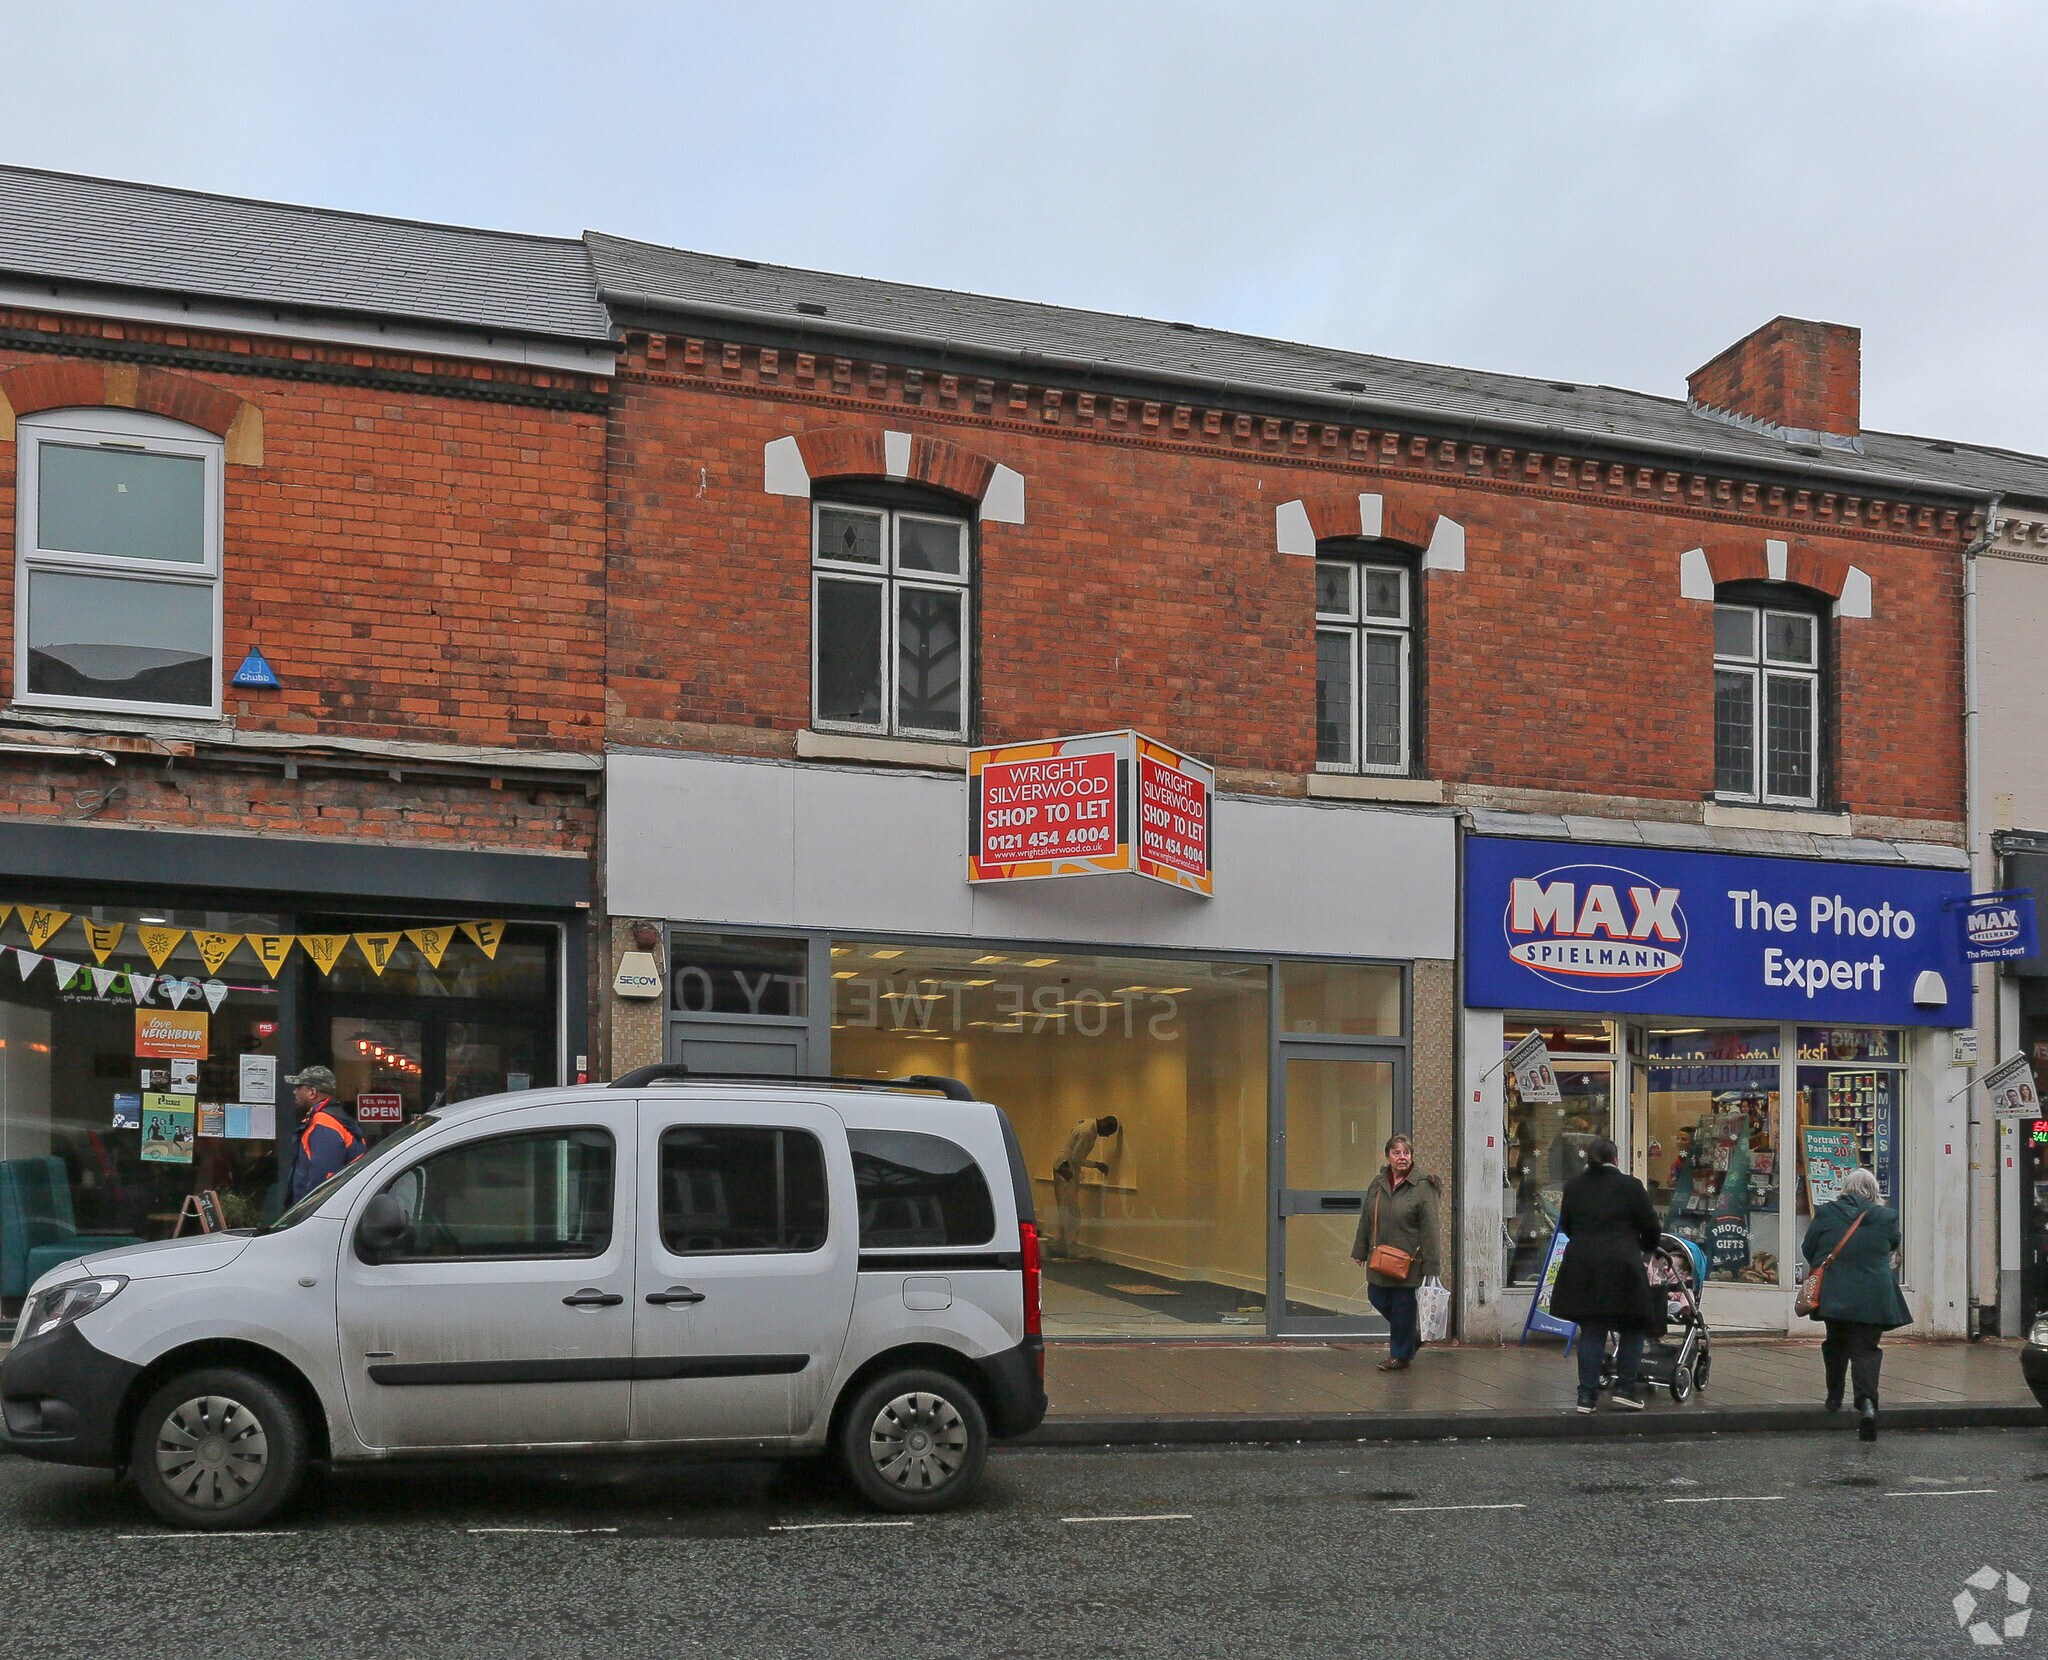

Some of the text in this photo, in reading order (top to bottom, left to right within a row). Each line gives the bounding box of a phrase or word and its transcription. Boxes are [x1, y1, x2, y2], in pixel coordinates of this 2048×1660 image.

[240, 673, 269, 682] Chubb
[1009, 760, 1087, 783] WRIGHT
[1154, 767, 1193, 797] WRIGHT
[989, 777, 1108, 804] SILVERWOOD
[1144, 781, 1203, 818] SILVERWOOD
[987, 799, 1110, 829] SHOP TO LET
[1144, 803, 1203, 842] SHOP TO LET
[988, 826, 1110, 850] 0121 454 4004
[1144, 830, 1203, 864] 0121 454 4004
[994, 843, 1102, 859] www.wrightsilverwood.co.uk
[1510, 877, 1681, 942] MAX
[1728, 889, 1916, 940] The Photo
[1967, 910, 2018, 931] MAX
[0, 910, 112, 951] ME
[1973, 930, 2015, 940] SPIELMANN
[1527, 945, 1666, 969] SPIELMANN
[1966, 947, 2025, 959] The Photo Expert
[619, 975, 656, 986] SECOM
[1764, 947, 1884, 999] Expert
[141, 1028, 203, 1041] NEIGHBOUR
[1986, 1057, 2027, 1086] INTERNATIONAL
[360, 1106, 400, 1117] OPEN
[1877, 1093, 1889, 1152] MUGS
[1806, 1134, 1840, 1145] Portrait
[1808, 1144, 1832, 1153] Packs
[1711, 1224, 1748, 1237] PHOTOS
[1716, 1240, 1744, 1249] GIFTS
